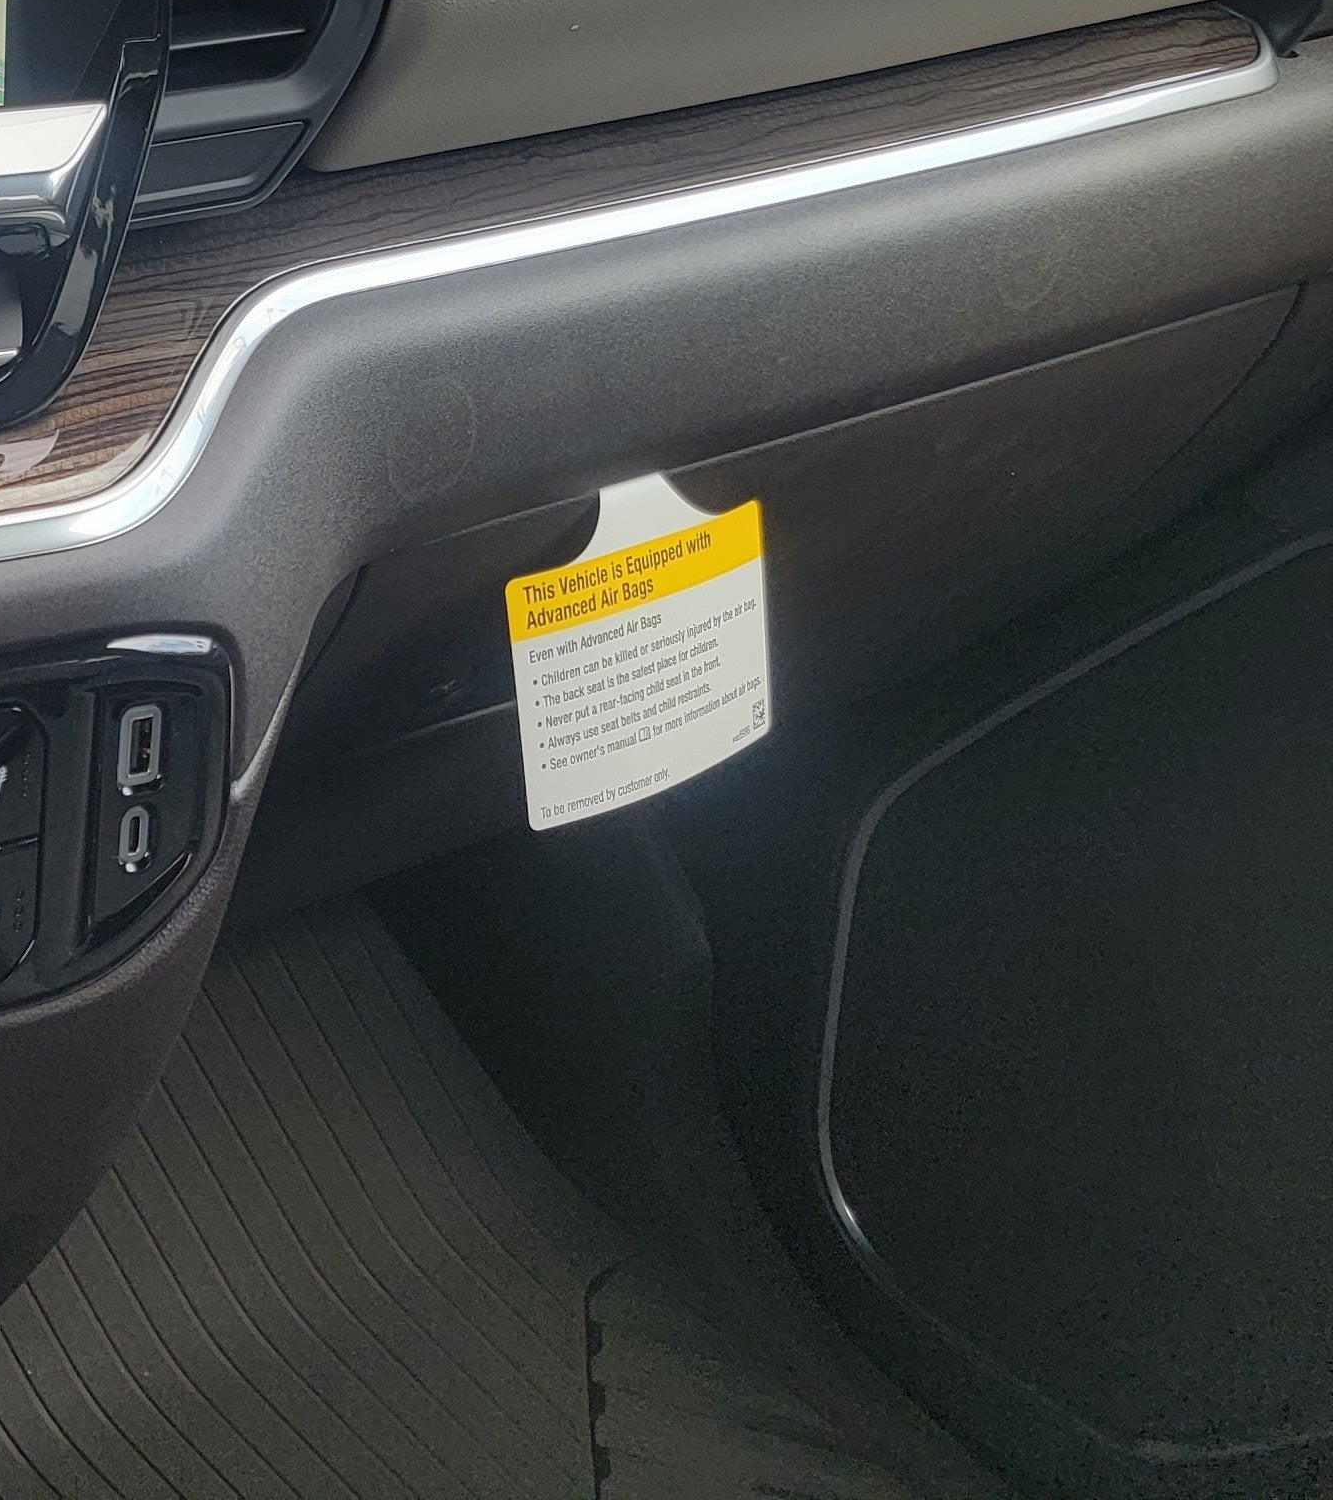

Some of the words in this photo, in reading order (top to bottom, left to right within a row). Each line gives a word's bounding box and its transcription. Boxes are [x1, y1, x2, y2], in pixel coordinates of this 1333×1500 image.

[522, 581, 555, 605] This
[558, 566, 608, 595] Vehicle
[610, 560, 623, 580] is
[625, 539, 683, 575] Equipped
[685, 530, 711, 554] with
[526, 593, 597, 630] Advanced
[600, 587, 618, 609] Air
[622, 578, 654, 601] Bags
[529, 647, 554, 664] Even
[556, 639, 578, 656] with
[580, 624, 624, 650] Advanced
[626, 619, 639, 636] Air
[640, 613, 662, 629] Bags
[541, 666, 581, 686] Children
[583, 661, 599, 675] can
[601, 656, 613, 669] be
[615, 645, 638, 665] killed
[640, 643, 649, 656] or
[651, 629, 685, 652] seriously
[686, 618, 712, 639] injured
[713, 615, 722, 628] by
[723, 610, 733, 622] the
[734, 603, 743, 618] air
[743, 598, 757, 611] bag.
[543, 694, 561, 707] The
[562, 685, 585, 702] back
[586, 678, 606, 695] seat
[607, 676, 615, 688] is
[616, 672, 630, 686] the
[631, 661, 656, 681] safest
[657, 654, 677, 673] place
[678, 649, 689, 663] for
[689, 638, 719, 658] children.
[545, 711, 573, 729] Never
[574, 705, 591, 723] put
[592, 704, 598, 715] a
[599, 688, 645, 714] rear-facing
[645, 678, 665, 697] child
[665, 671, 683, 689] seat
[682, 669, 690, 683] in
[691, 665, 703, 679] the
[703, 656, 721, 674] front.
[547, 731, 581, 750] Always
[583, 725, 599, 739] use
[600, 717, 620, 734] seat
[620, 711, 642, 727] belts
[642, 703, 658, 720] and
[658, 695, 676, 713] child
[677, 682, 712, 706] restraints.
[540, 806, 552, 819] To
[553, 803, 565, 817] be
[567, 790, 605, 813] removed
[605, 787, 616, 802] by
[617, 772, 653, 798] customer
[653, 767, 671, 783] only.
